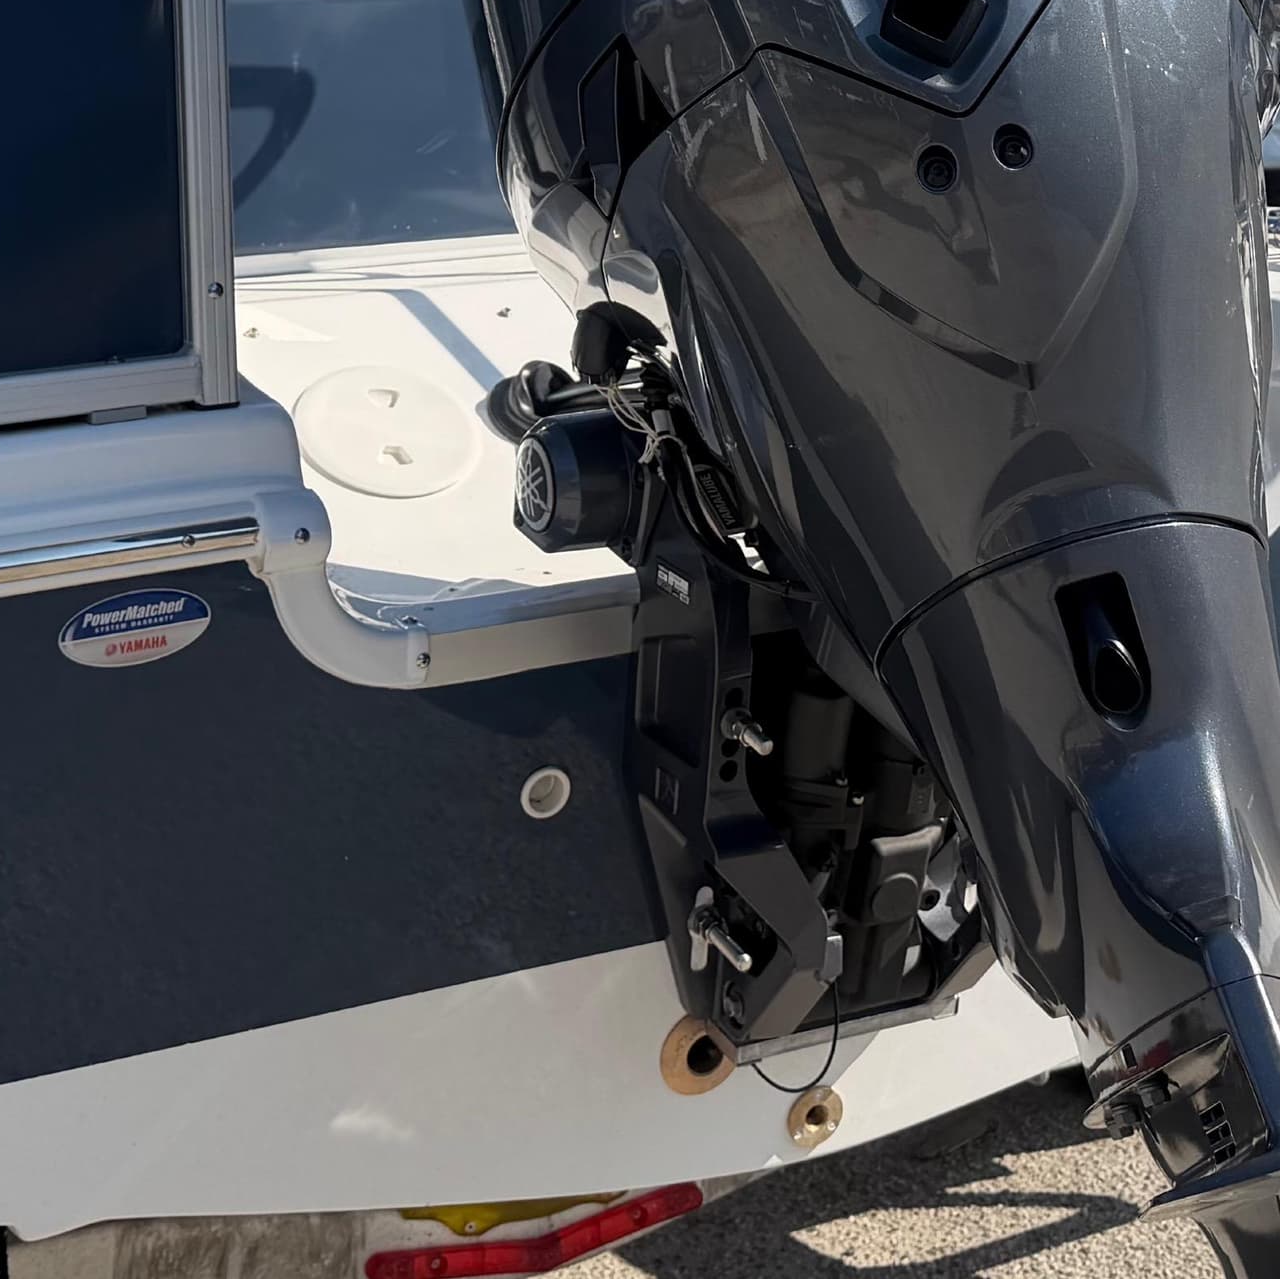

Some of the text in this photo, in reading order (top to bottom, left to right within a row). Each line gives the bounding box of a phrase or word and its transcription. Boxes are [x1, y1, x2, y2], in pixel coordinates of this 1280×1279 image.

[702, 473, 736, 525] YAMALUBE
[82, 598, 185, 628] PowerMatched
[120, 635, 167, 654] YAMAHA
